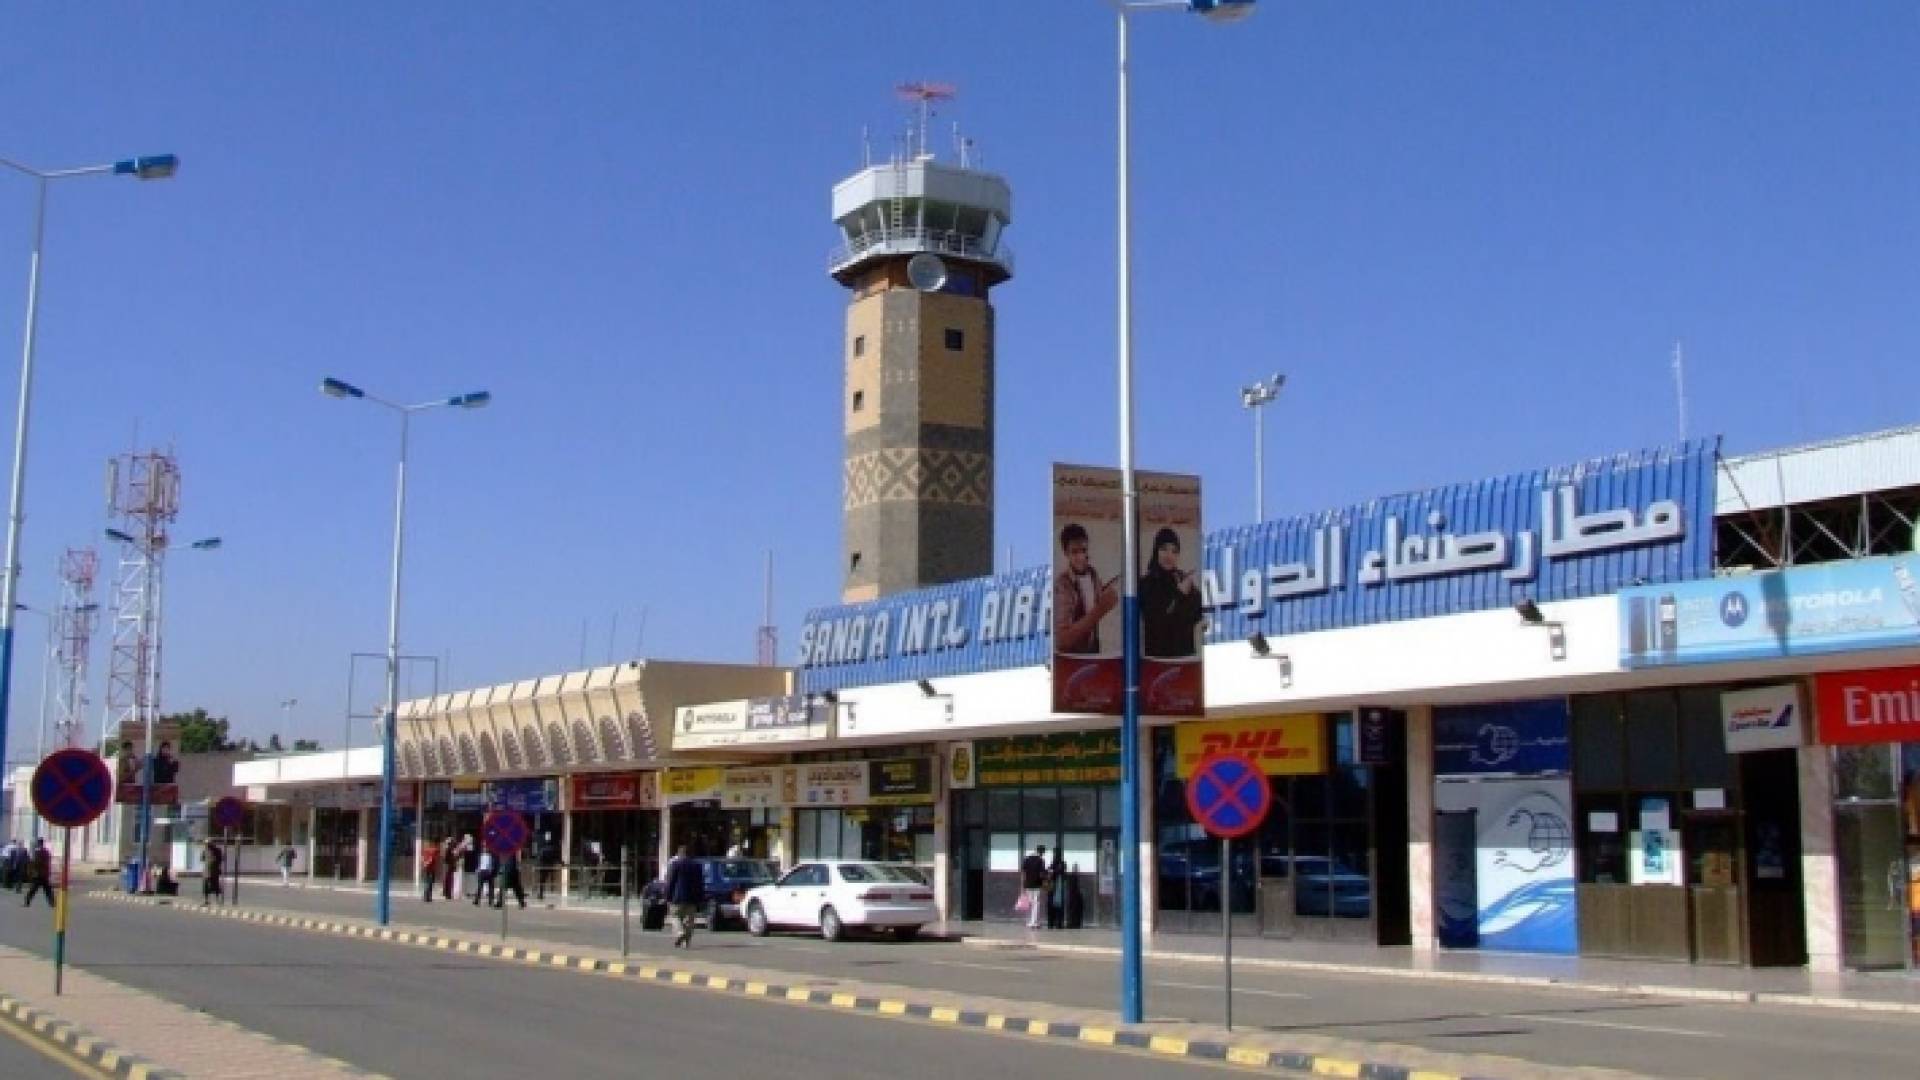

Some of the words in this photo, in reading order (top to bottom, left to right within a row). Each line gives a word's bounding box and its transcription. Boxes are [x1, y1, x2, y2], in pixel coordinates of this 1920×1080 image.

[1357, 513, 1505, 584] صنعاء
[1502, 486, 1681, 580] مطار
[1201, 728, 1289, 760] DHL
